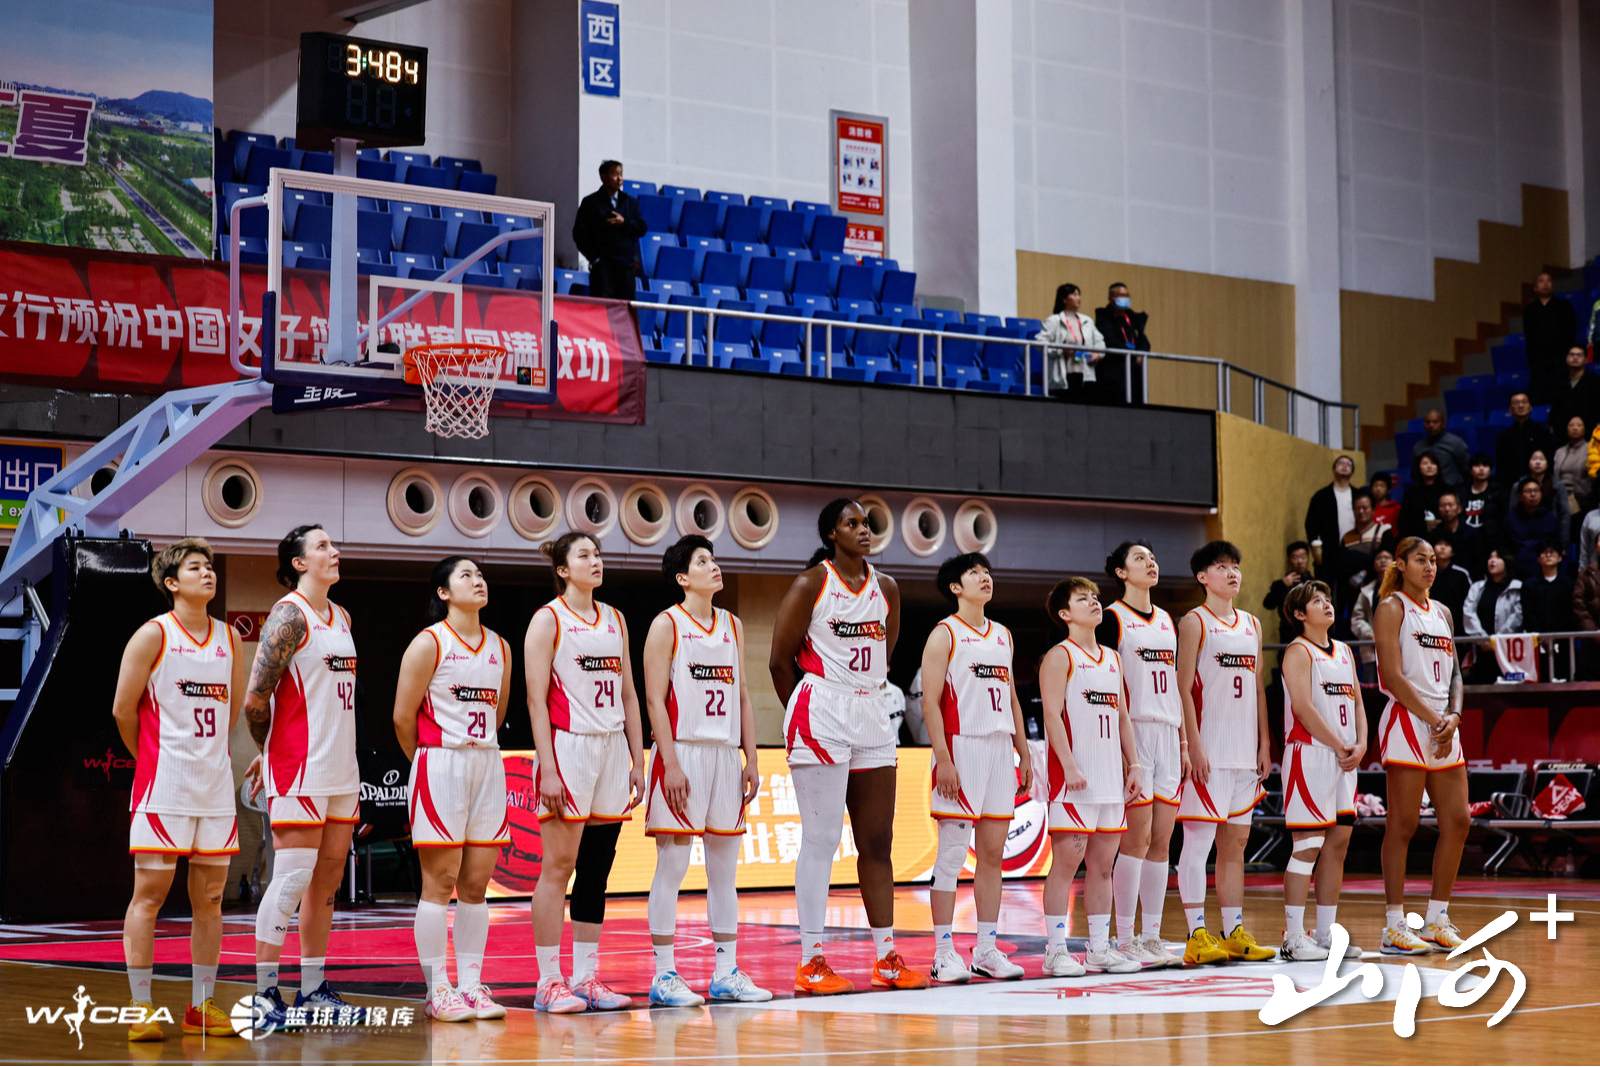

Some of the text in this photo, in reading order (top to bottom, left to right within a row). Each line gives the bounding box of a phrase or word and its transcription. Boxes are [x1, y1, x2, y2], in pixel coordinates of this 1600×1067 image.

[586, 13, 616, 88] 西区
[0, 89, 96, 166] 夏
[0, 459, 58, 492] 出口
[849, 647, 871, 672] 20
[1506, 638, 1524, 662] 10
[694, 665, 733, 678] SHANXI
[1152, 670, 1167, 694] 10
[1433, 661, 1440, 682] 0
[185, 683, 225, 695] SHANXI
[338, 682, 353, 710] 42
[595, 680, 615, 708] 24
[988, 687, 1002, 712] 12
[1233, 676, 1242, 698] 9
[705, 690, 726, 716] 22
[1339, 704, 1347, 727] 8
[194, 708, 216, 737] 59
[468, 711, 486, 739] 29
[1099, 714, 1110, 739] 11
[360, 782, 408, 801] SPALDIN
[1007, 820, 1032, 841] CBA
